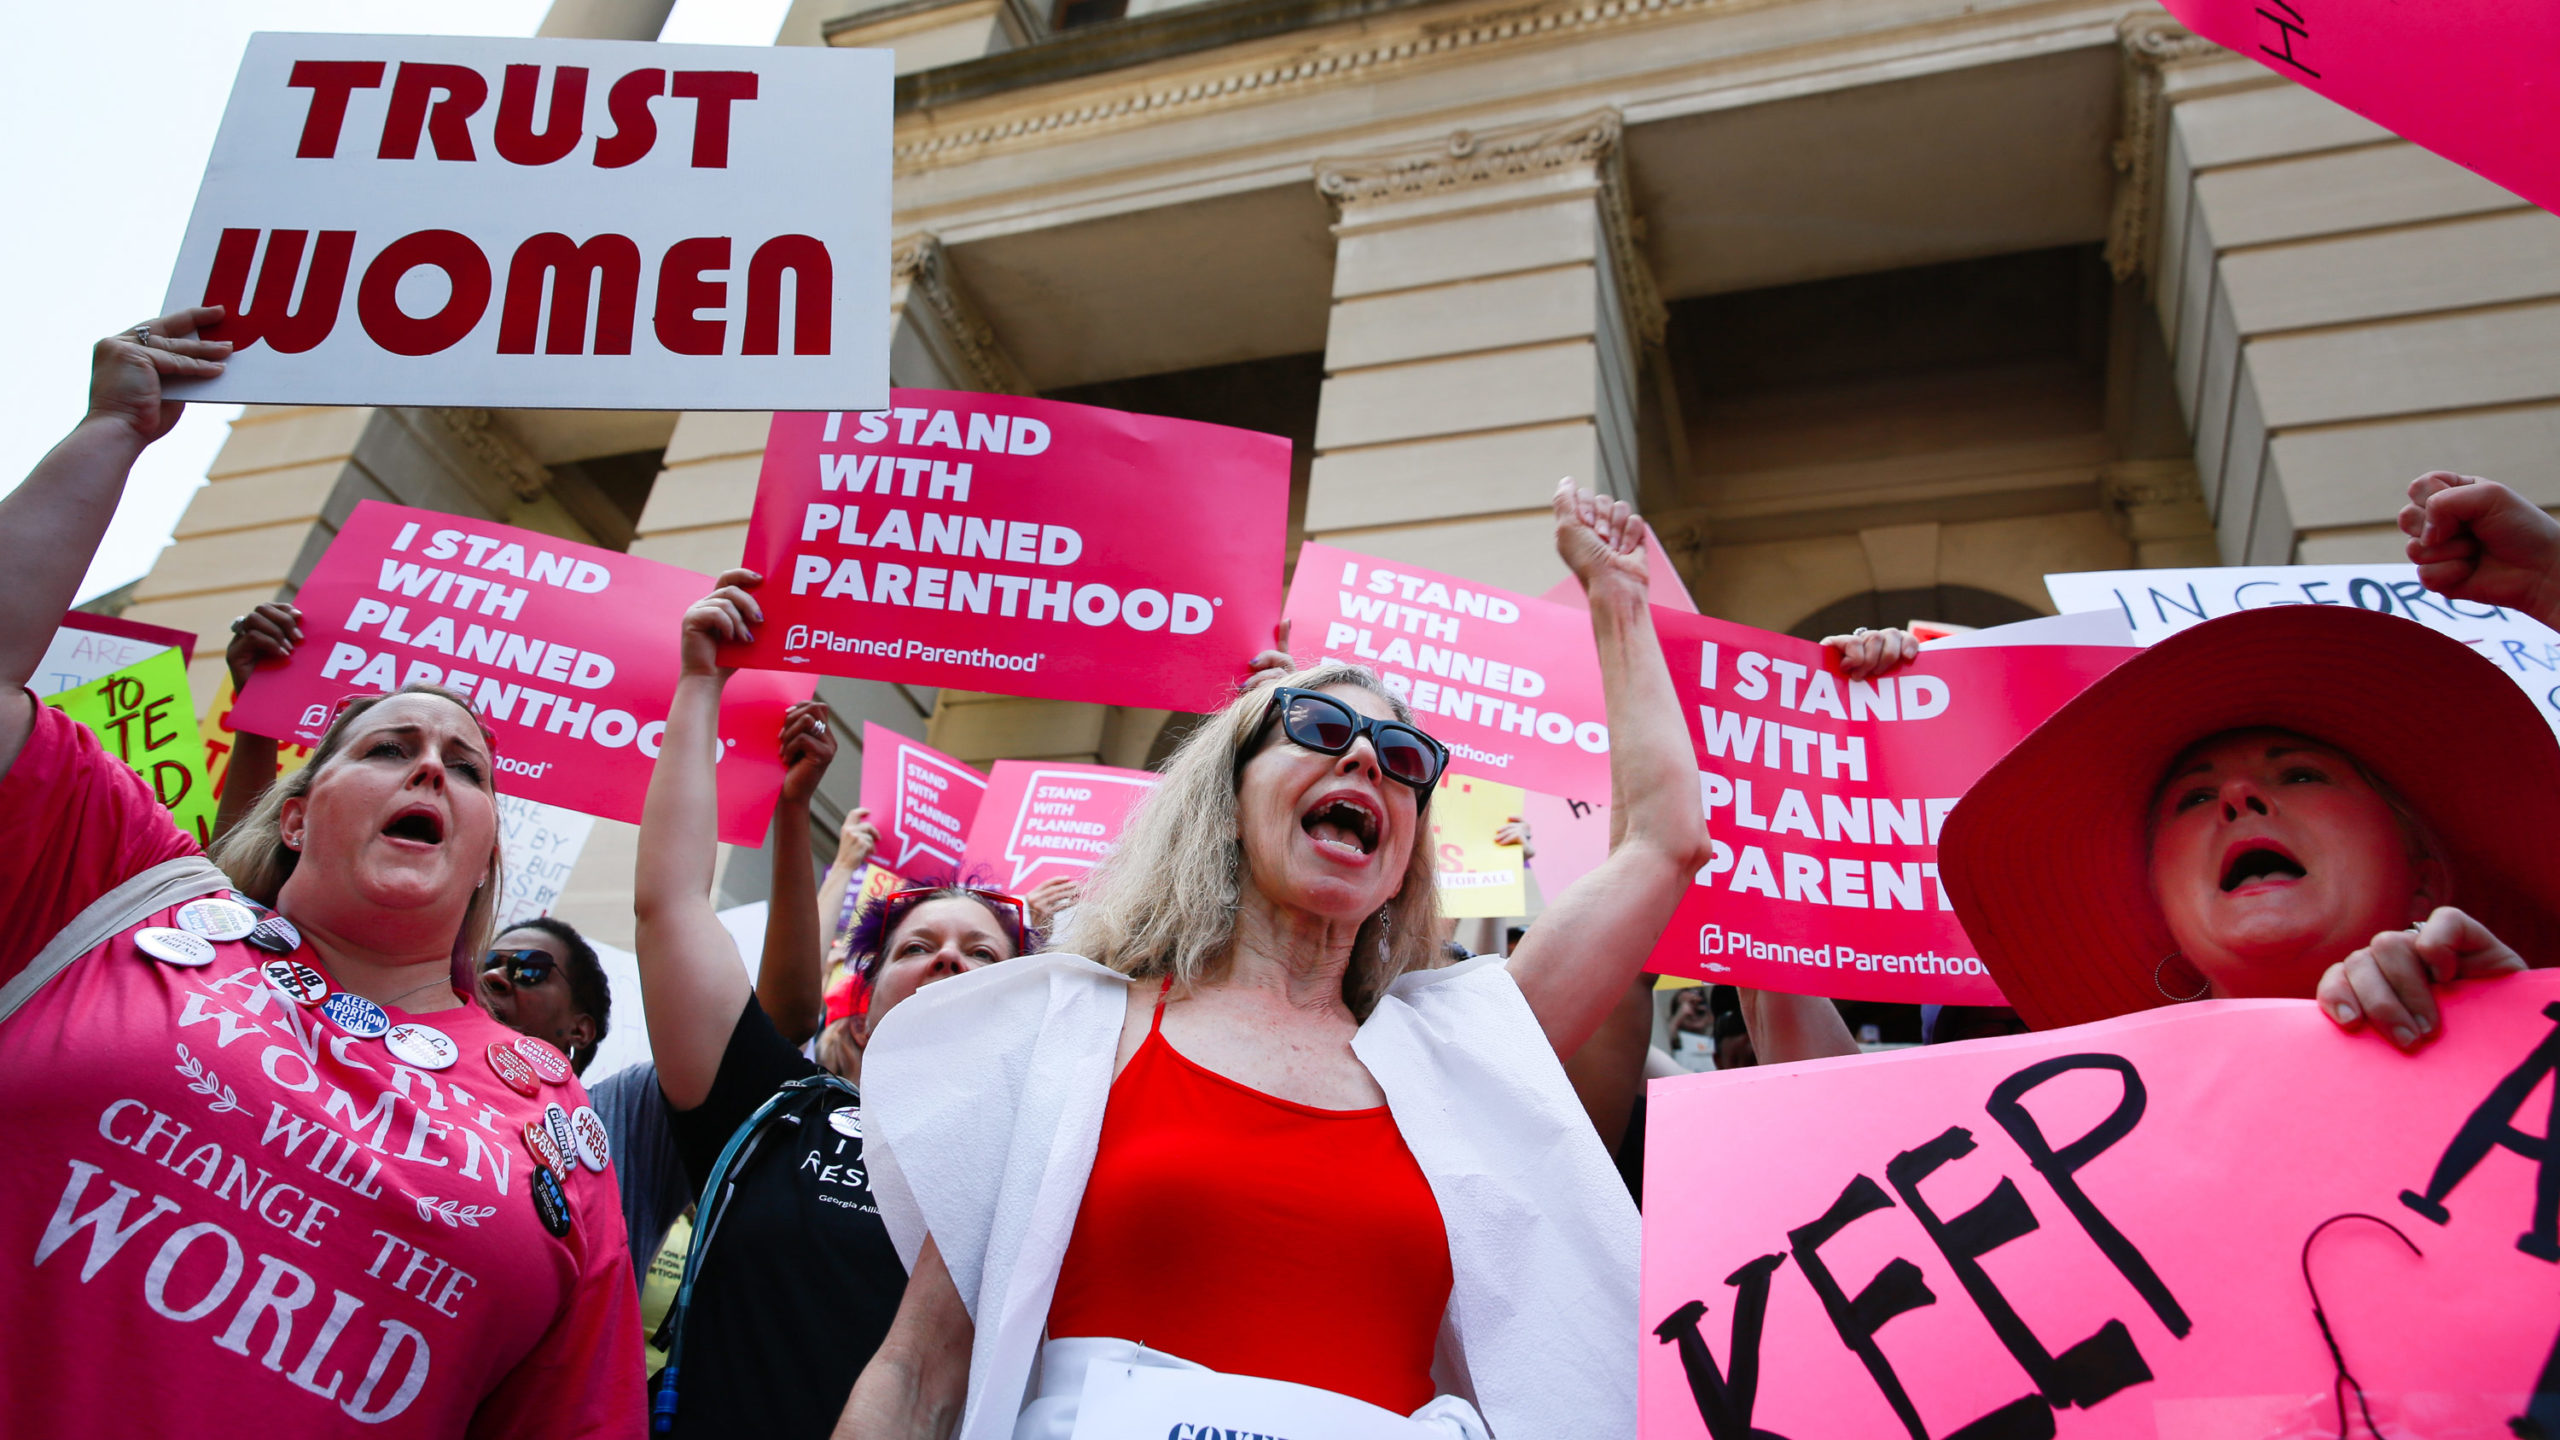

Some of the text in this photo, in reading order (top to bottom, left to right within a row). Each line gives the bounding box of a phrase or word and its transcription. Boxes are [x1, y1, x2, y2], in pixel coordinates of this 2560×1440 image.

[287, 60, 759, 169] TRUST
[200, 228, 833, 357] WOMEN
[822, 407, 1051, 456] I STAND
[819, 453, 973, 502] WITH
[391, 521, 611, 595] I STAND
[801, 502, 1083, 566] PLANNED
[377, 558, 529, 622] WITH
[1341, 561, 1520, 625] I STAND
[2113, 582, 2208, 630] IN
[1338, 590, 1461, 644] WITH
[71, 635, 136, 667] ARE
[343, 597, 616, 690] PLANNED
[810, 630, 902, 660] Planned
[1325, 621, 1546, 698] PLANNED
[1700, 640, 1950, 722] I STAND
[1699, 704, 1868, 782] WITH
[906, 779, 939, 804] WITH
[907, 763, 948, 791] STAND
[1037, 786, 1092, 801] STAND
[906, 797, 961, 832] PLANNED
[1026, 818, 1106, 837] PLANNED
[1033, 802, 1075, 816] WITH
[1699, 769, 1962, 846] PLANNE
[904, 813, 966, 853] PARENTHO
[1021, 834, 1111, 855] PARENTHO
[525, 855, 573, 882] BUT
[1695, 838, 1954, 911] PARENT
[297, 965, 323, 987] HB
[1727, 930, 1990, 975] Planned Parenthoo
[325, 999, 385, 1028] ABORTION
[331, 1011, 371, 1032] LEGAL
[341, 994, 375, 1012] KEEP
[522, 1043, 566, 1073] resisting
[526, 1039, 544, 1052] This
[177, 991, 511, 1196] WOMEN
[259, 1100, 386, 1200] WILL
[530, 1128, 566, 1181] WOMEN
[579, 1112, 607, 1154] HARD
[586, 1135, 607, 1169] ROE
[99, 1098, 477, 1318] CHANGE THE
[542, 1169, 570, 1222] DEFY
[818, 1194, 858, 1209] Georgia
[1652, 1052, 2193, 1440] KEEP
[33, 1158, 432, 1424] WORLD
